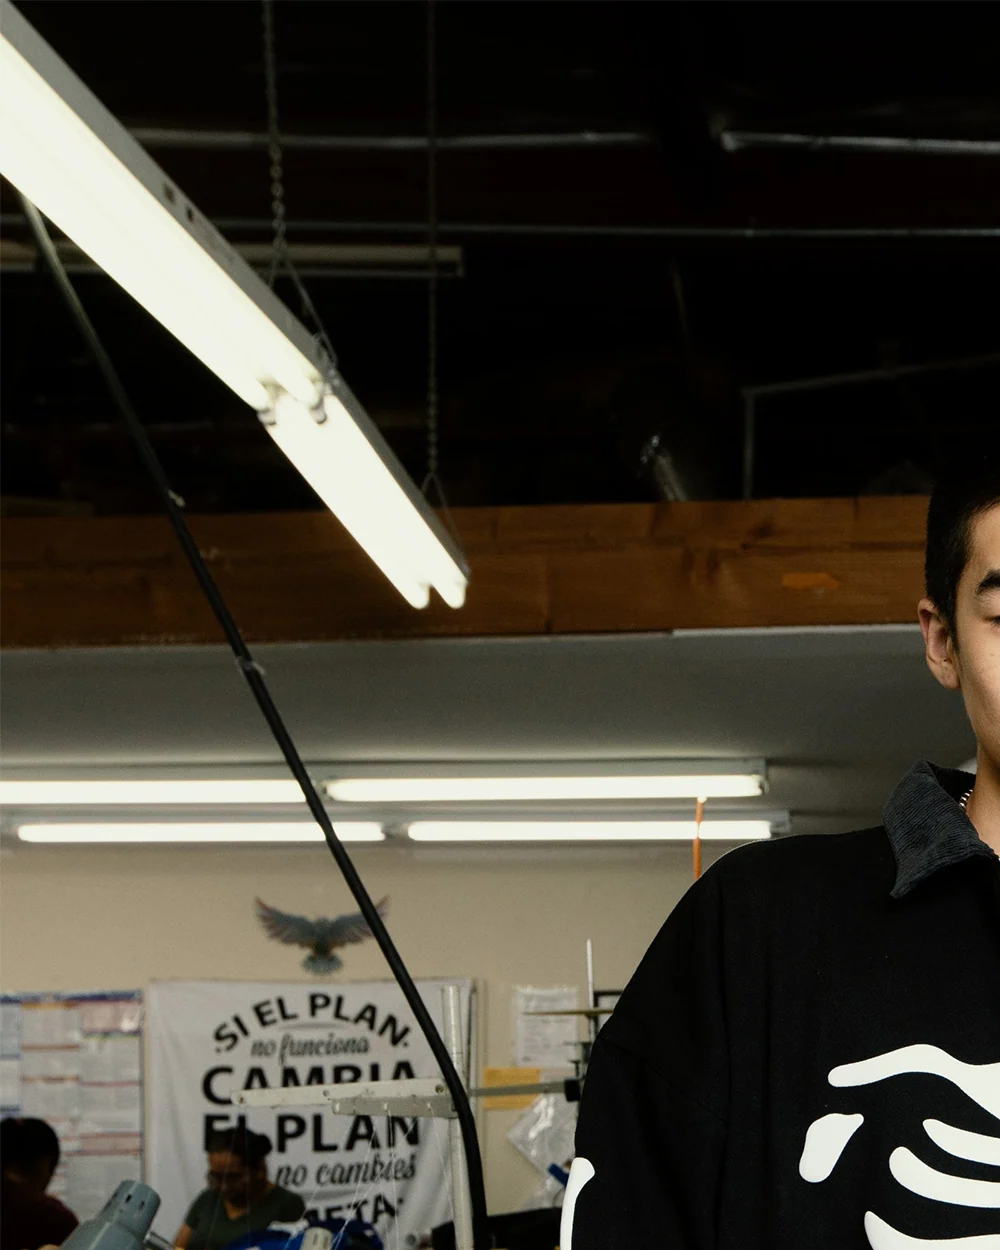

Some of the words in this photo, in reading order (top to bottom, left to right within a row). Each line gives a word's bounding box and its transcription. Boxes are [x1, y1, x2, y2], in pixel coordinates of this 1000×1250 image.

[253, 996, 298, 1028] EL
[251, 1040, 277, 1057] no
[279, 1032, 370, 1065] funciona
[276, 1113, 420, 1153] PLAN
[276, 1162, 308, 1187] no
[316, 1153, 417, 1186] cambies
